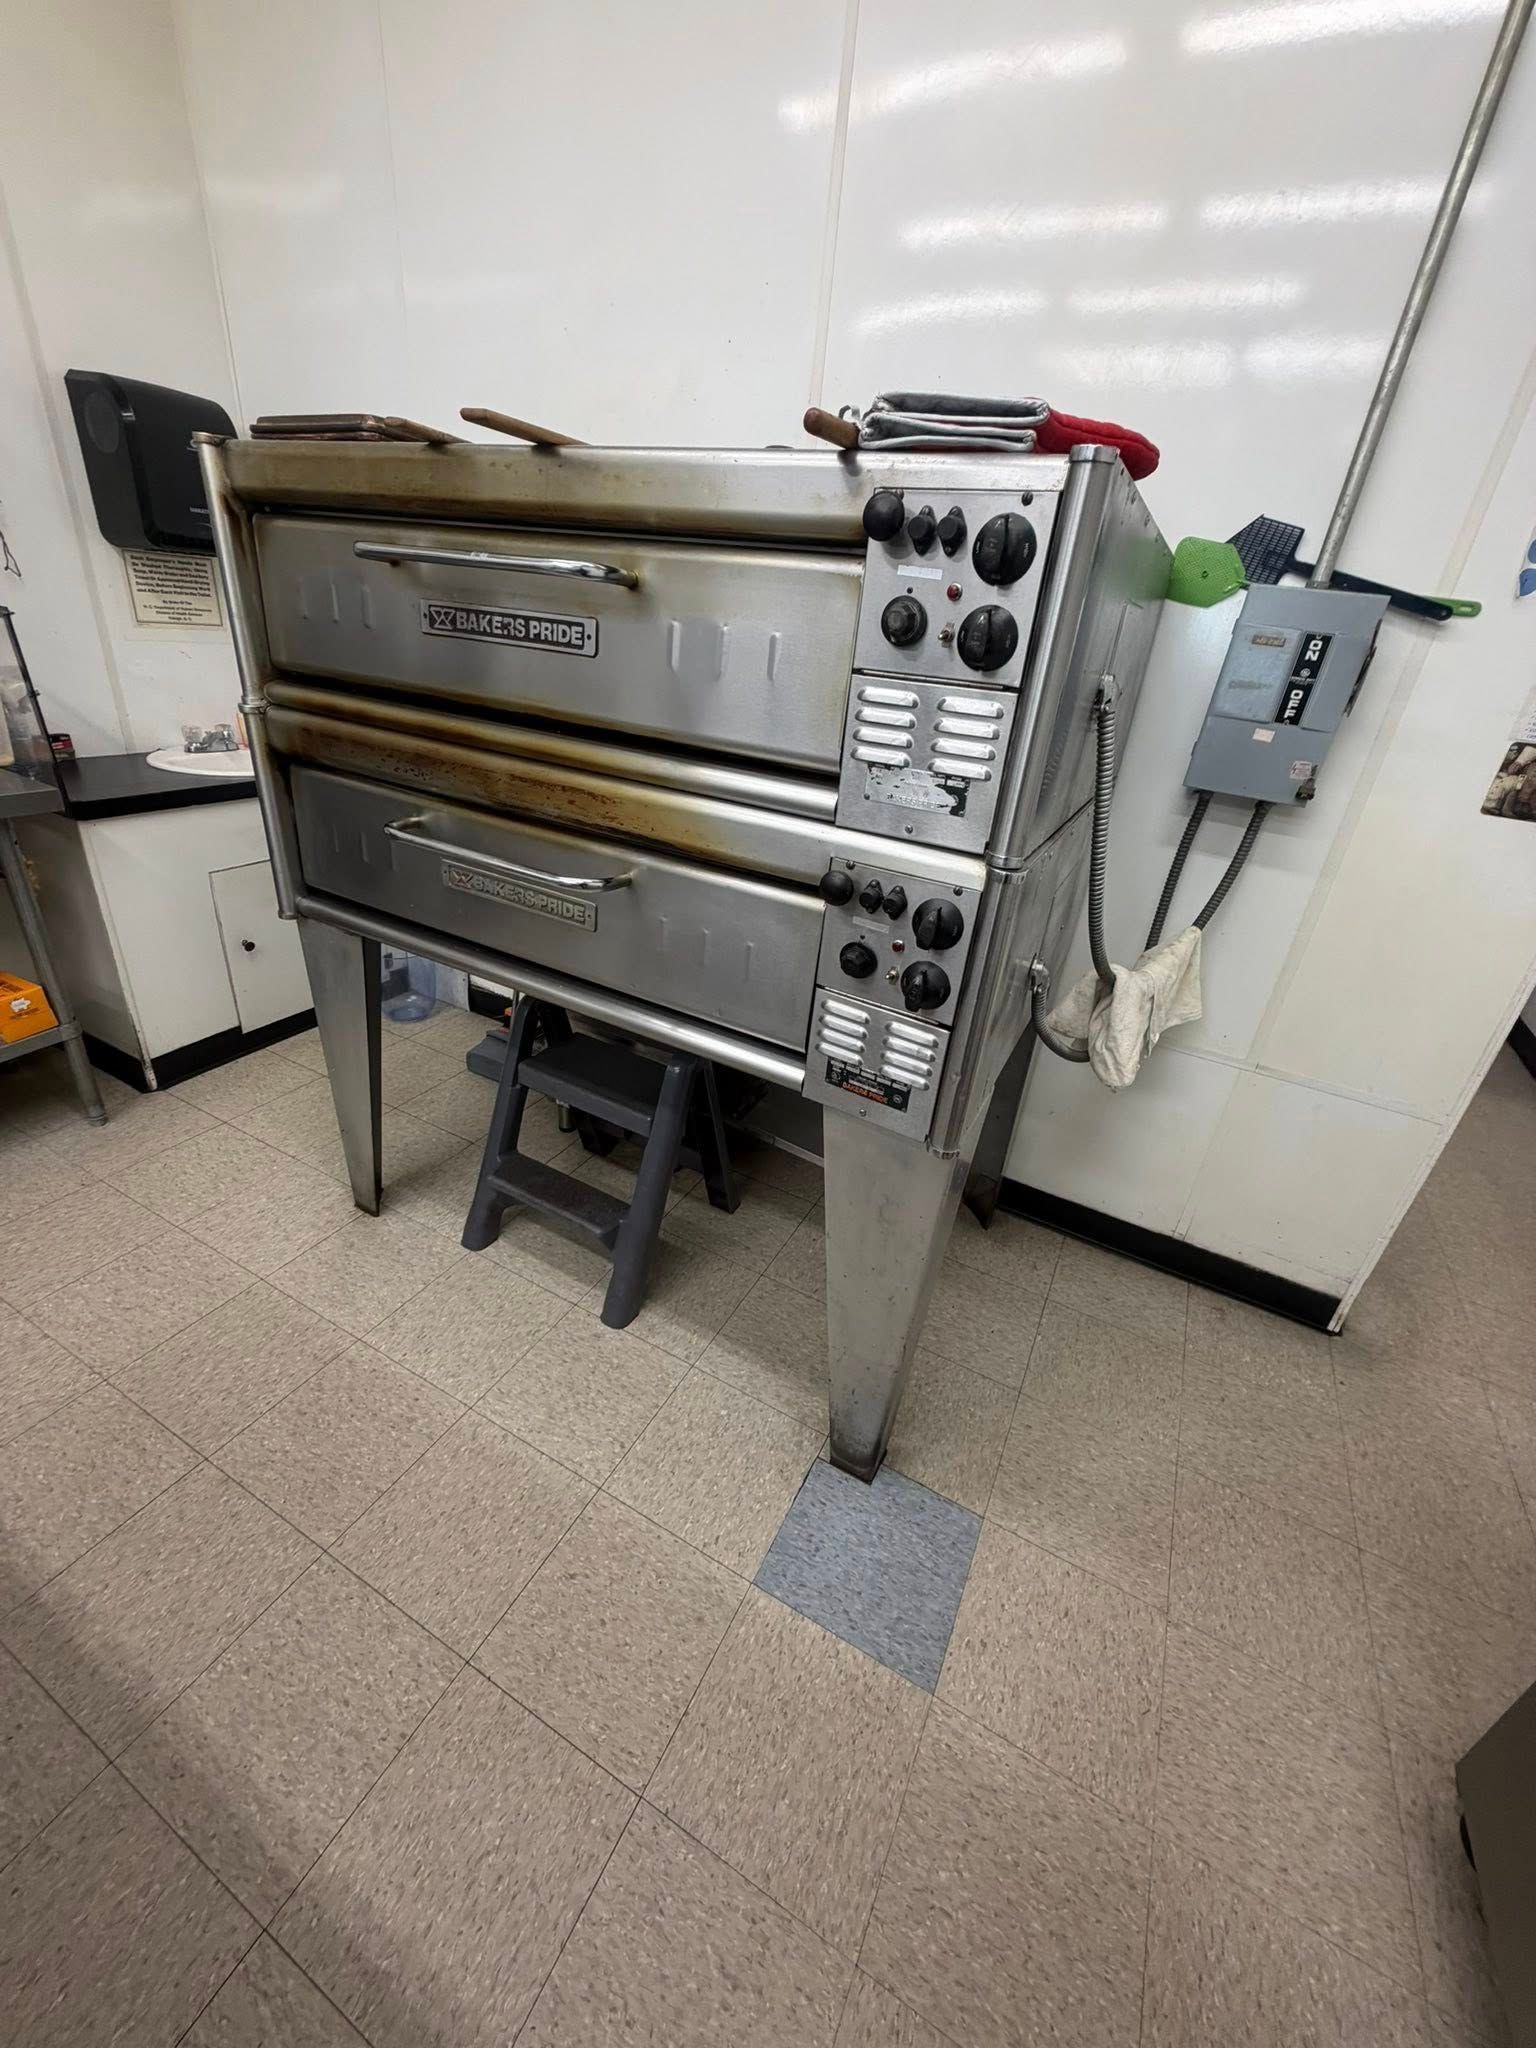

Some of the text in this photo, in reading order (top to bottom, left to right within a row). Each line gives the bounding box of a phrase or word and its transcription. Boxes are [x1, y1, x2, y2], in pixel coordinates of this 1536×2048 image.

[456, 611, 583, 645] BAKERS PRIDE
[1304, 640, 1322, 661] ON
[1284, 690, 1304, 719] OFF
[471, 876, 586, 922] BAKERS PRIDE
